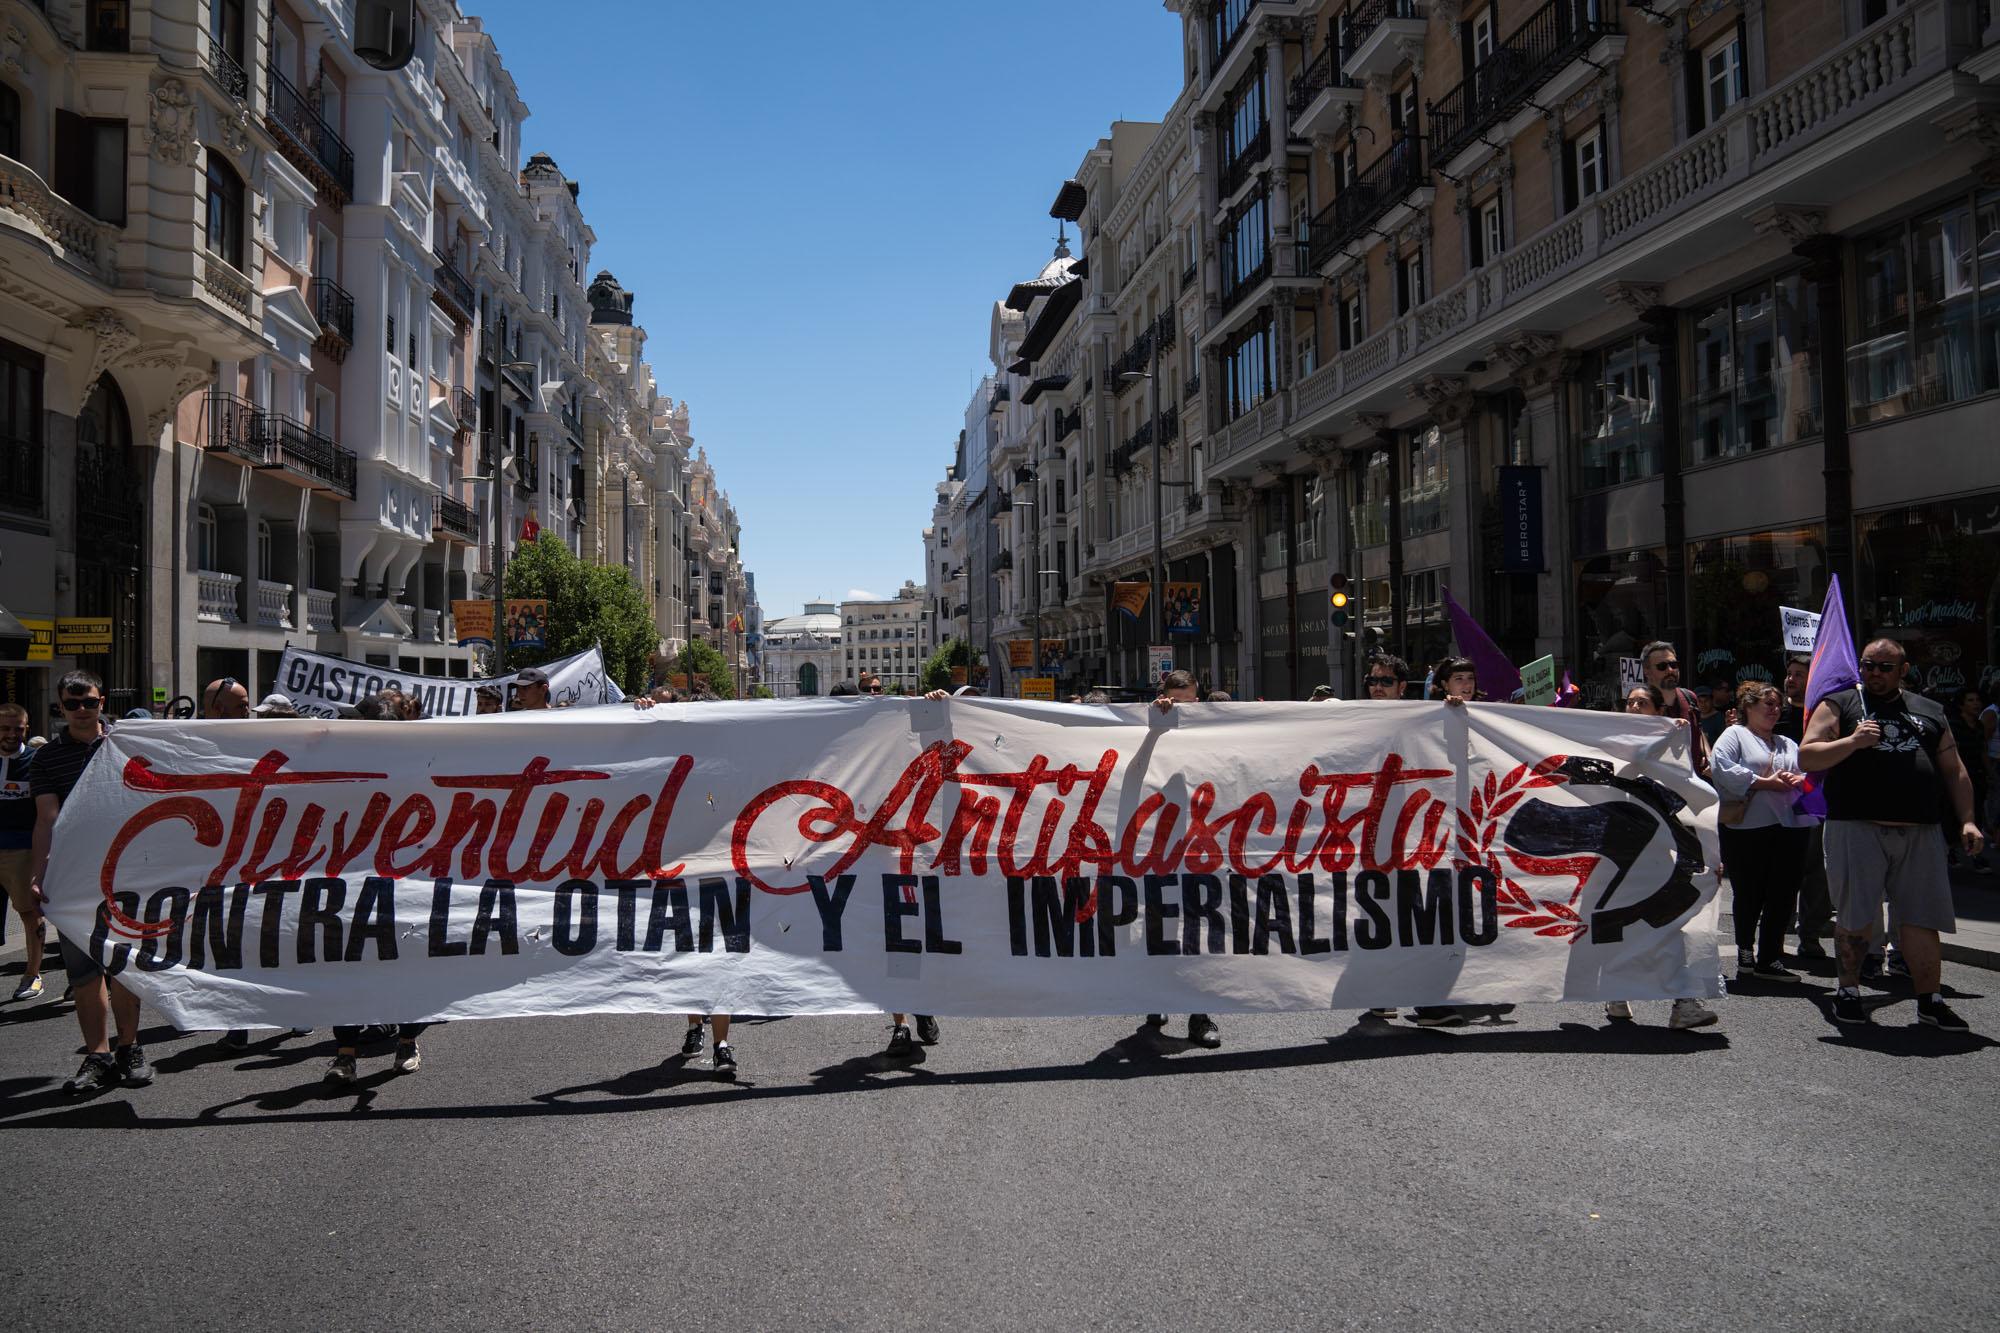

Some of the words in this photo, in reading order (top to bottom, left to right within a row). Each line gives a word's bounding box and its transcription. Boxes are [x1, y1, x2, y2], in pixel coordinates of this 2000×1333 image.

[1519, 488, 1529, 562] IBEROSTAR
[1785, 611, 1810, 628] Guerras
[1926, 598, 1977, 622] Madrid
[1299, 619, 1329, 633] ASCAN
[1791, 632, 1811, 647] todas
[1621, 658, 1643, 683] PAZ
[101, 749, 694, 940] Juventud
[731, 738, 1453, 926] Antifascista
[88, 877, 398, 976] CONTRA
[428, 876, 520, 958] LA
[551, 876, 751, 956] OTAN
[807, 874, 859, 952] Y
[883, 874, 962, 956] EL
[1007, 864, 1499, 960] IMPERIALISMO
